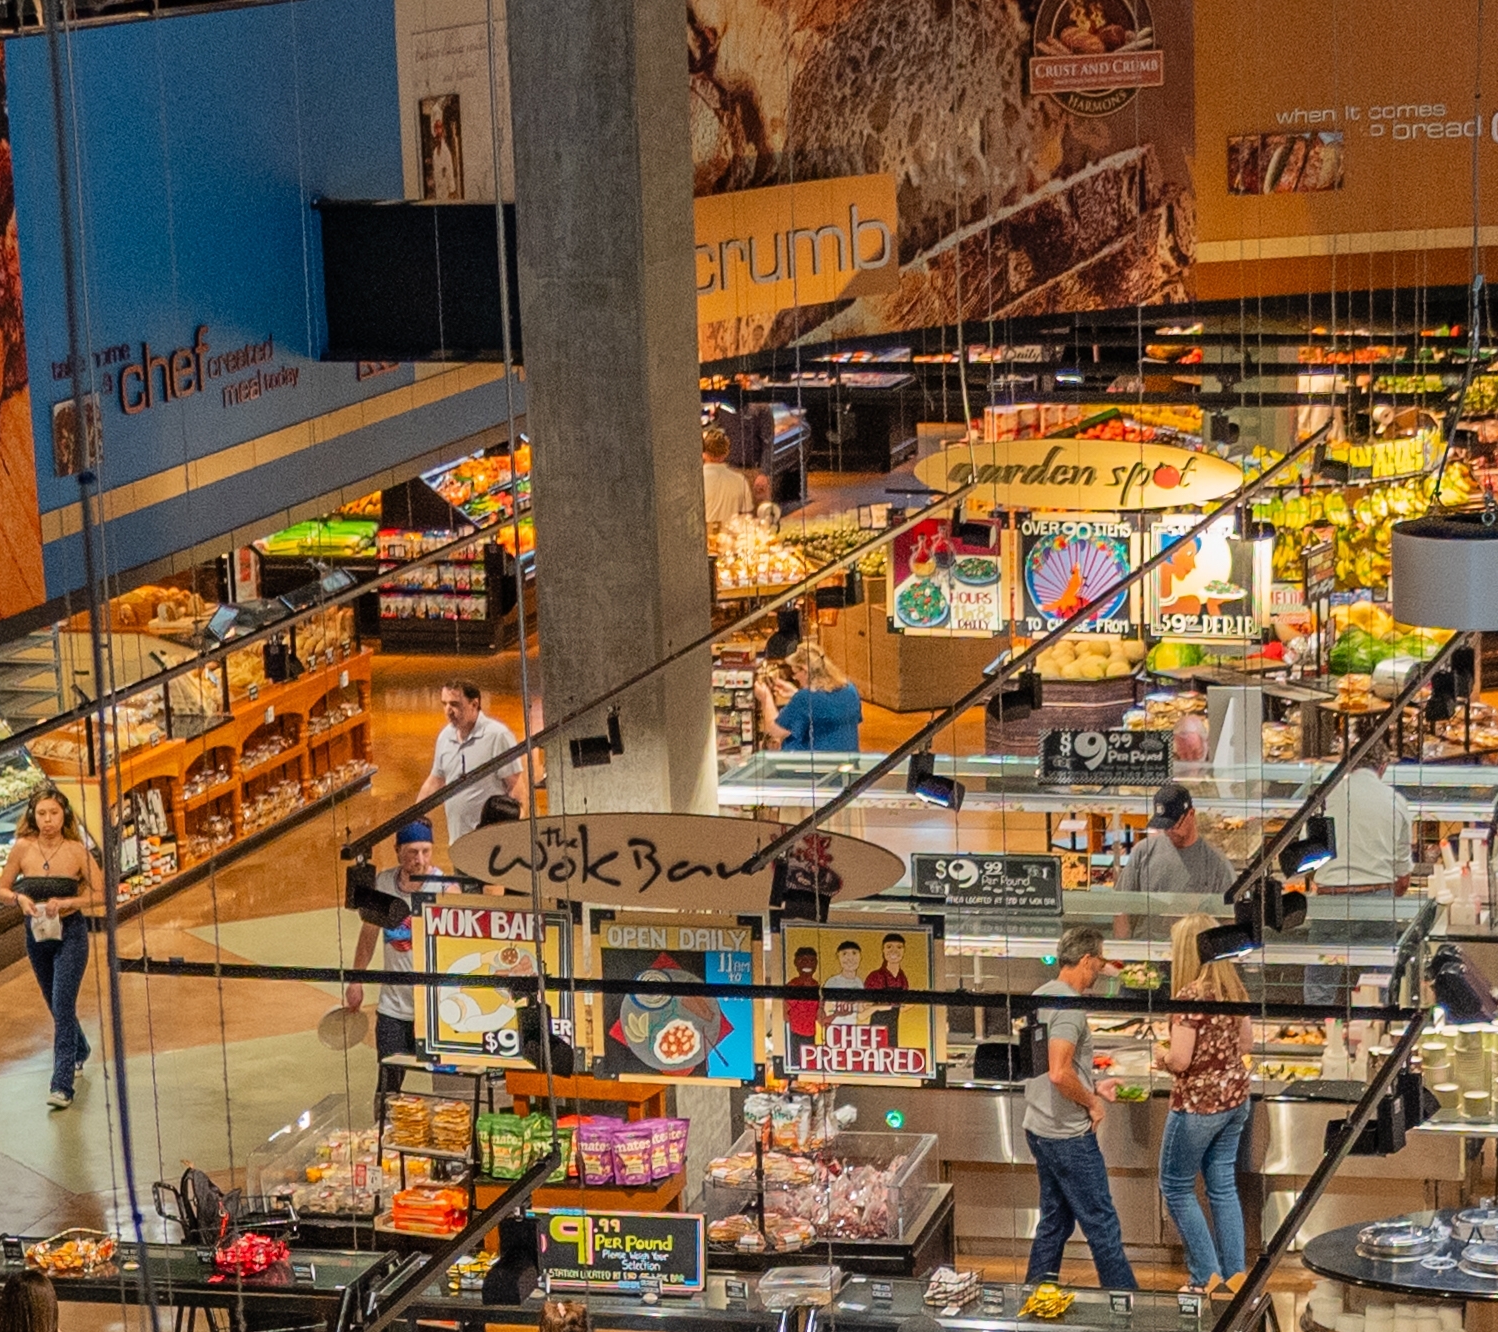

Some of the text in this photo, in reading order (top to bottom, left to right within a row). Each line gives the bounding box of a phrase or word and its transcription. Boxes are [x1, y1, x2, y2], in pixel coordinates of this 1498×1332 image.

[1035, 58, 1158, 80] CRUST AND CRUMB
[1276, 106, 1336, 126] when
[1368, 102, 1446, 120] comes
[1392, 115, 1481, 139] bread
[695, 204, 893, 296] crumb
[119, 325, 209, 415] chef
[207, 335, 274, 380] created
[222, 364, 300, 408] meal today
[1022, 522, 1131, 538] OVER 90 ITEMS
[949, 591, 992, 604] HOURS
[957, 618, 990, 631] DAILY
[1026, 617, 1129, 633] TO FROM
[541, 826, 578, 850] the
[489, 825, 621, 886] Wok
[426, 907, 487, 937] WOK
[607, 926, 747, 951] OPEN DAILY
[827, 1025, 886, 1048] CHEF
[802, 1045, 925, 1074] PREPARED
[614, 1139, 651, 1152] mates
[622, 1260, 661, 1271] Selection
